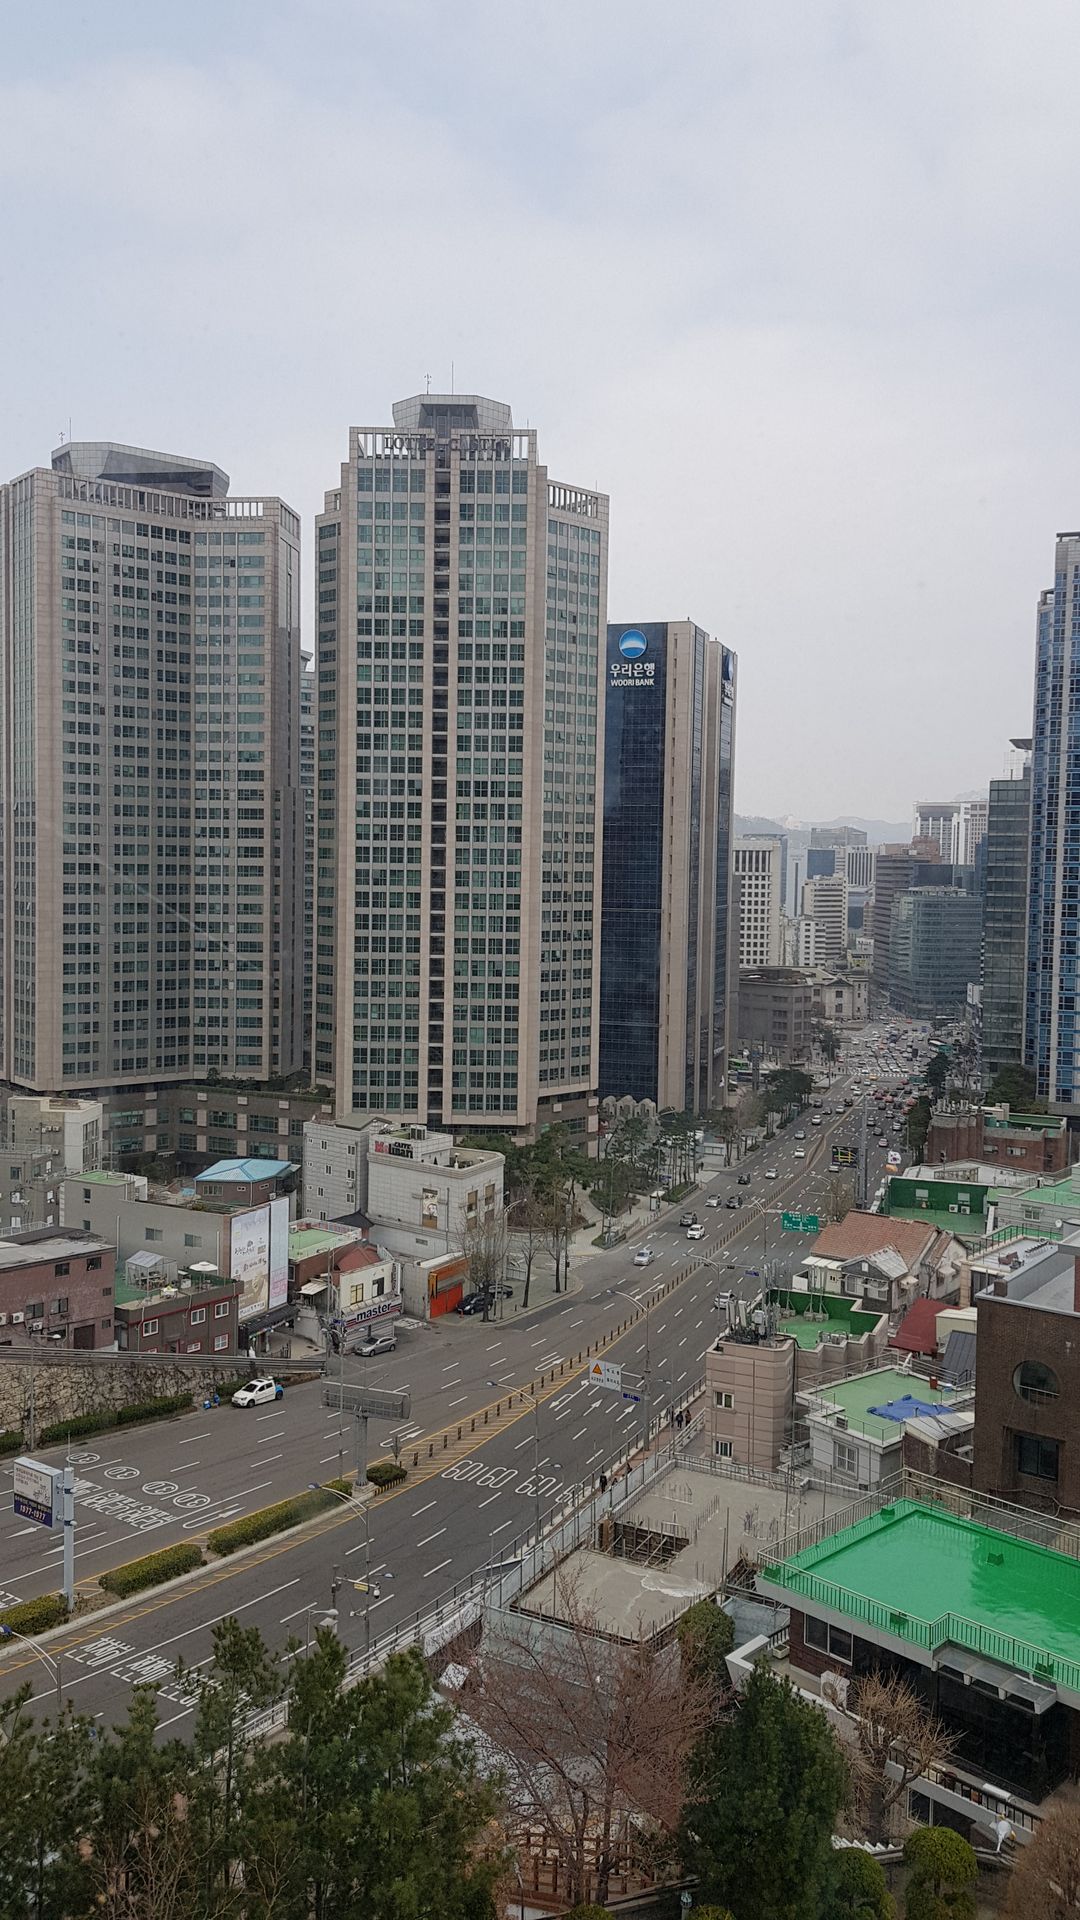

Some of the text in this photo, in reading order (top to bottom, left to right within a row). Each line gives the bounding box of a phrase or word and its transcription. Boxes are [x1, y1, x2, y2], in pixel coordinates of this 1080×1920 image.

[384, 437, 436, 450] LOTTE
[610, 662, 655, 677] 우리은행
[610, 678, 654, 687] WOORI BANK
[356, 1302, 392, 1322] master
[64, 1636, 136, 1667] 천천히
